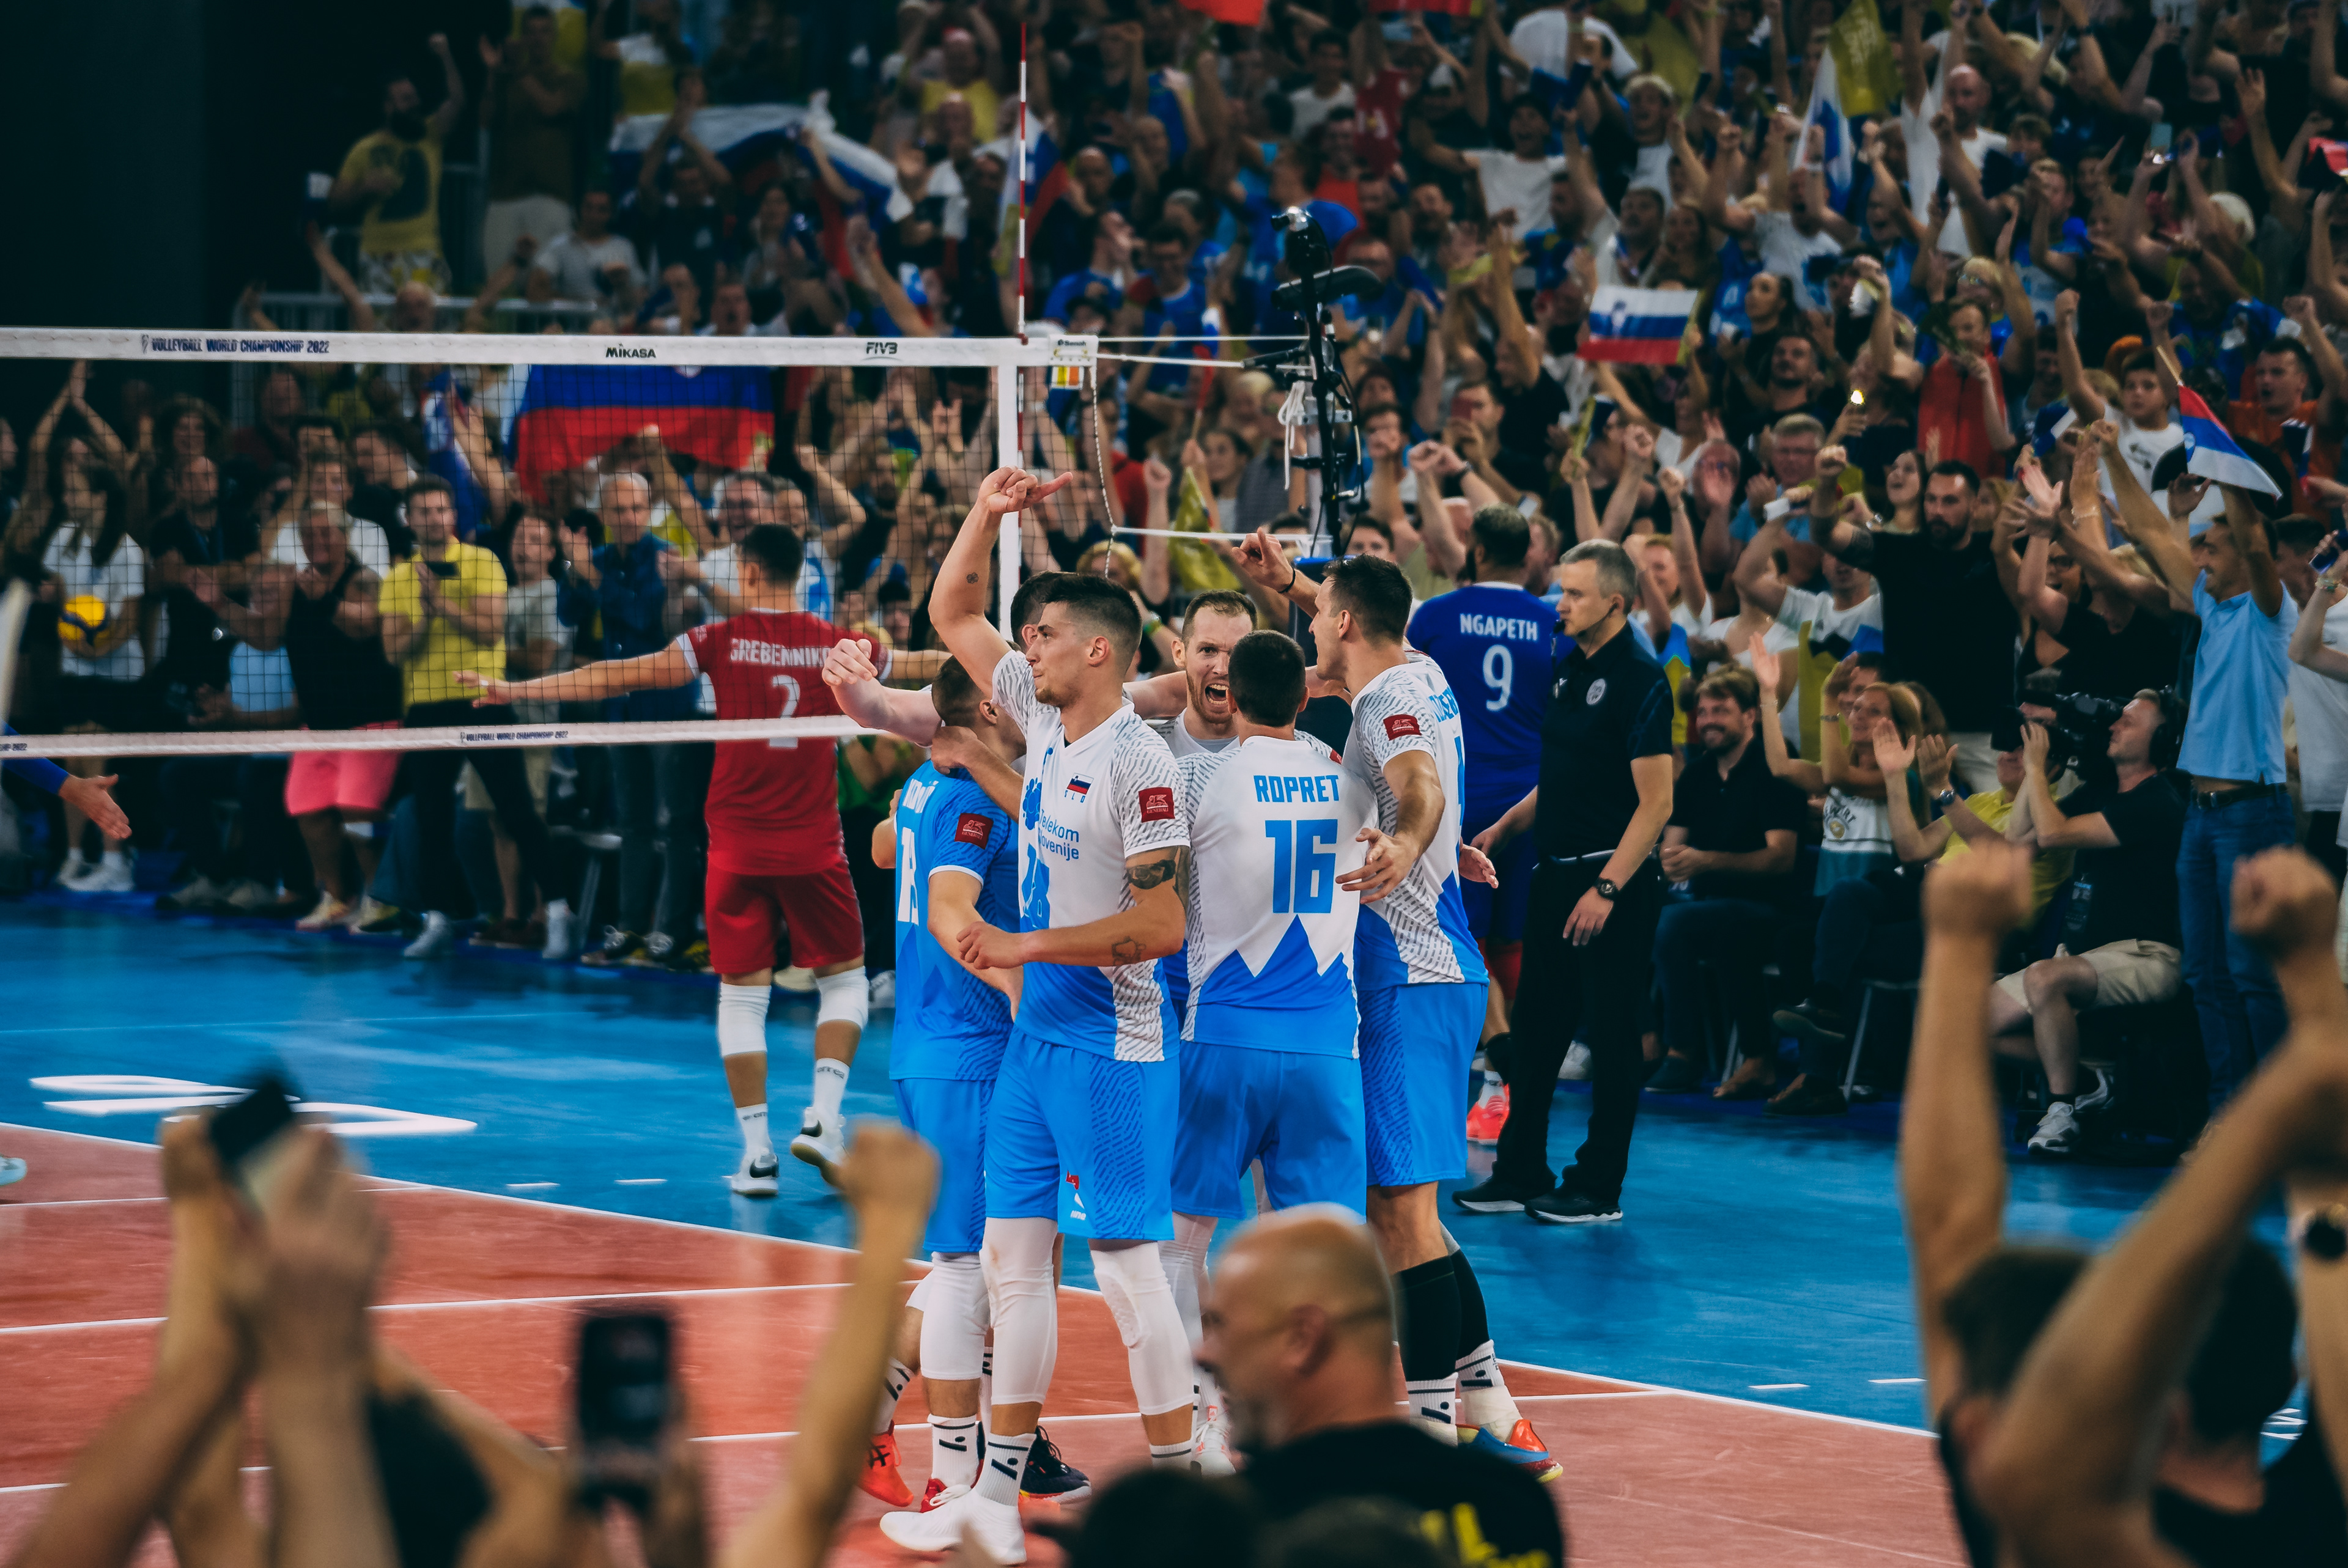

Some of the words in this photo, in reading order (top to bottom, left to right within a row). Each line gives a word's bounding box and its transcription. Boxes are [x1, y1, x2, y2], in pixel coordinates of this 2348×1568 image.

[152, 337, 203, 352] VOLLEYBALL
[206, 338, 238, 353] WORLD
[240, 339, 305, 353] CHAMPIONSHIP
[307, 340, 330, 354] 2022
[605, 344, 657, 358] MIKASA
[1460, 613, 1538, 641] NGAPETH
[1482, 644, 1513, 712] 9
[769, 674, 800, 749] 2
[1064, 790, 1086, 803] SLO
[1253, 775, 1340, 803] ROPRET
[1039, 809, 1080, 843] Telekom
[1264, 819, 1338, 914] 16
